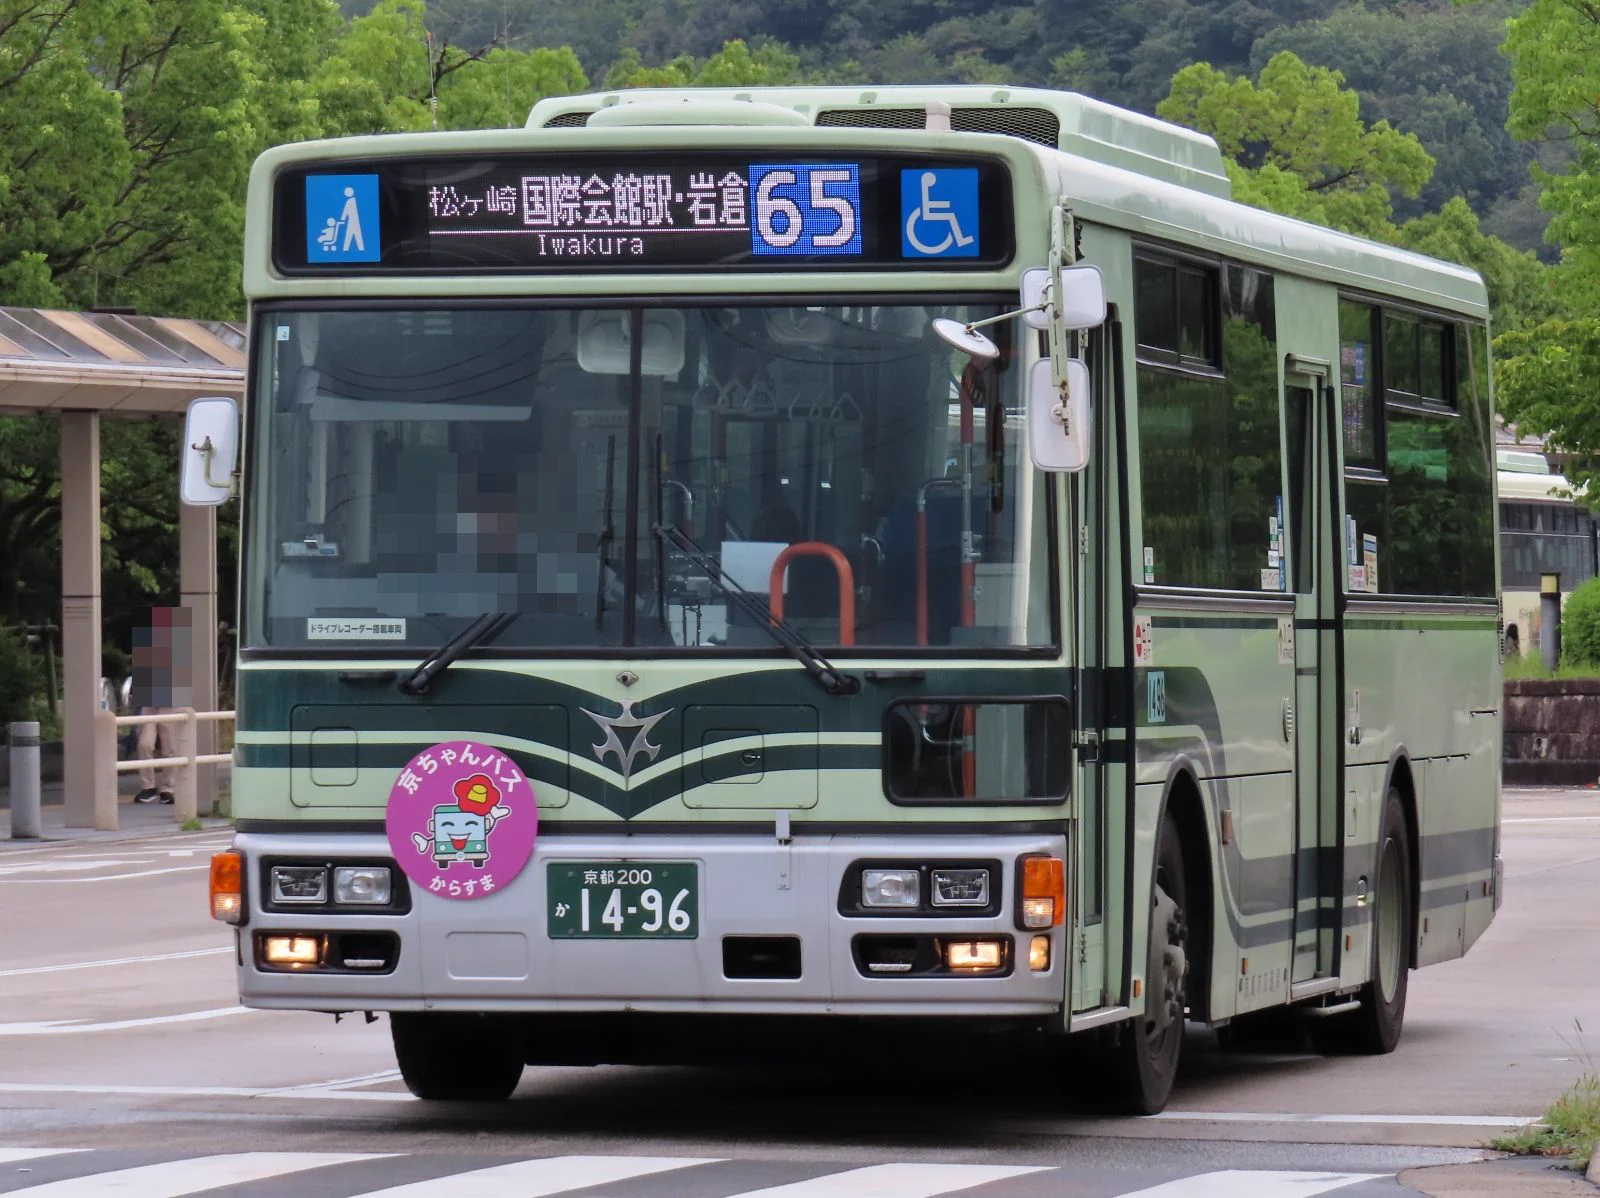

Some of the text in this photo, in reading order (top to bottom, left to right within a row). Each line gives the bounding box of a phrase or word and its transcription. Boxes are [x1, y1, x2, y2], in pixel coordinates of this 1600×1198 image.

[522, 171, 749, 226] 国際会館駅・岩倉
[755, 167, 858, 248] 65
[538, 233, 645, 256] Iwakura
[1148, 676, 1165, 718] 1496
[398, 744, 522, 795] 京ちゃんバス
[430, 874, 496, 896] からすま
[555, 888, 691, 932] か 14-96
